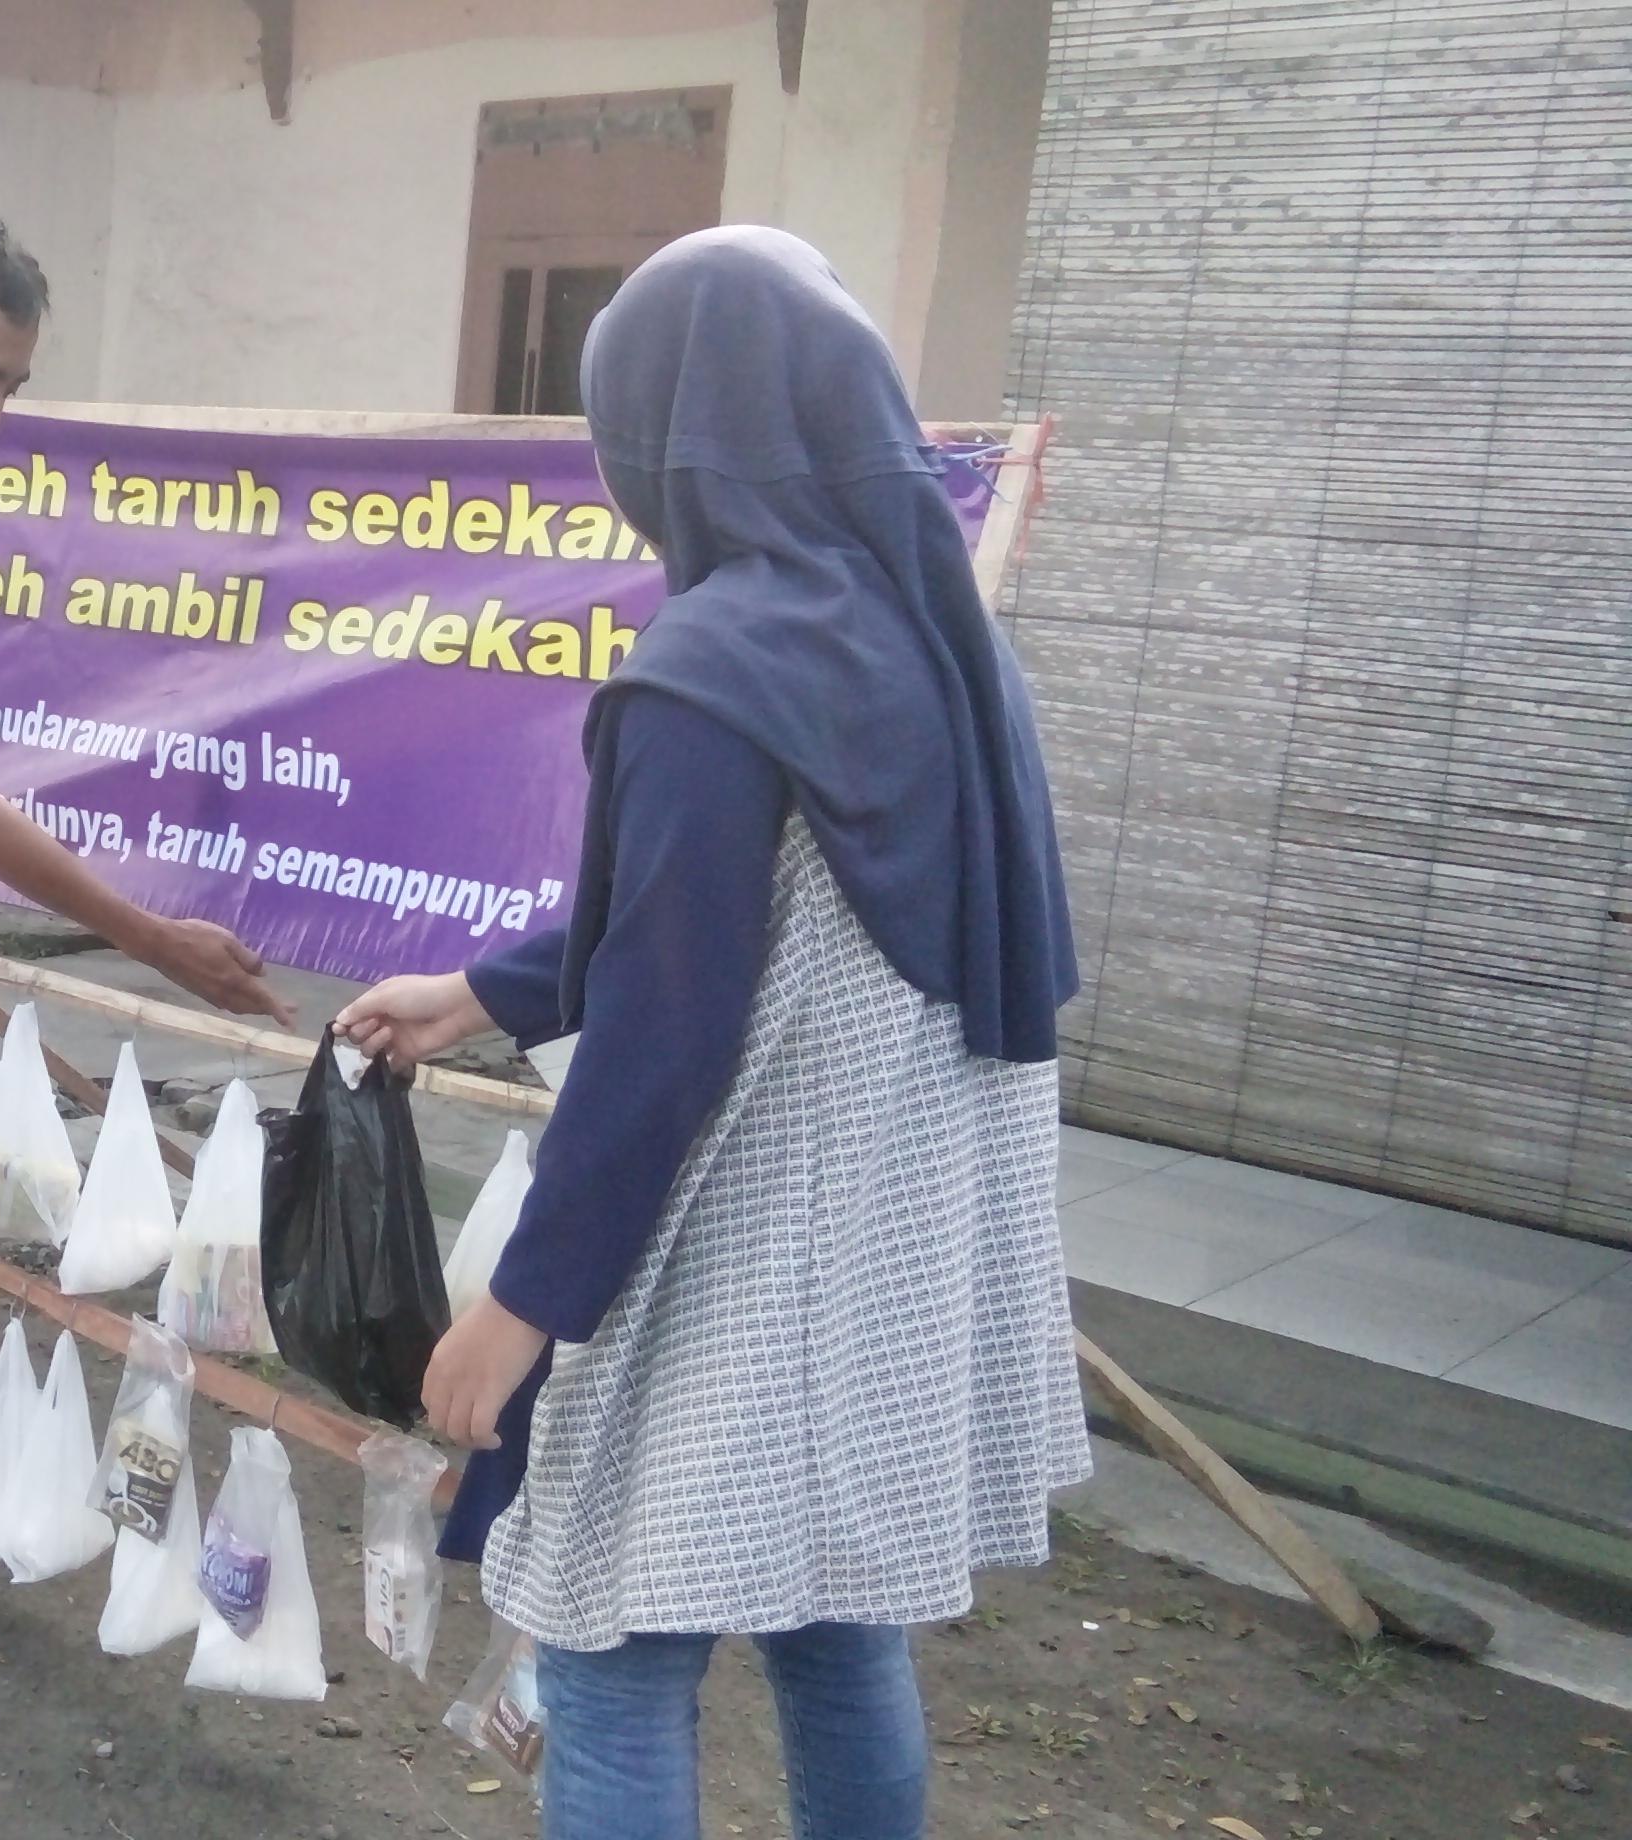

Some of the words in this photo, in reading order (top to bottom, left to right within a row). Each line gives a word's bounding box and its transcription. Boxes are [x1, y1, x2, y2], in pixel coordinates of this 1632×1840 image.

[91, 460, 280, 536] taruh
[65, 572, 264, 645] ambil
[283, 594, 638, 681] sedekah
[150, 728, 247, 791] yang
[261, 731, 351, 807] lain,
[146, 810, 247, 874] taruh
[118, 1440, 181, 1482] ABC
